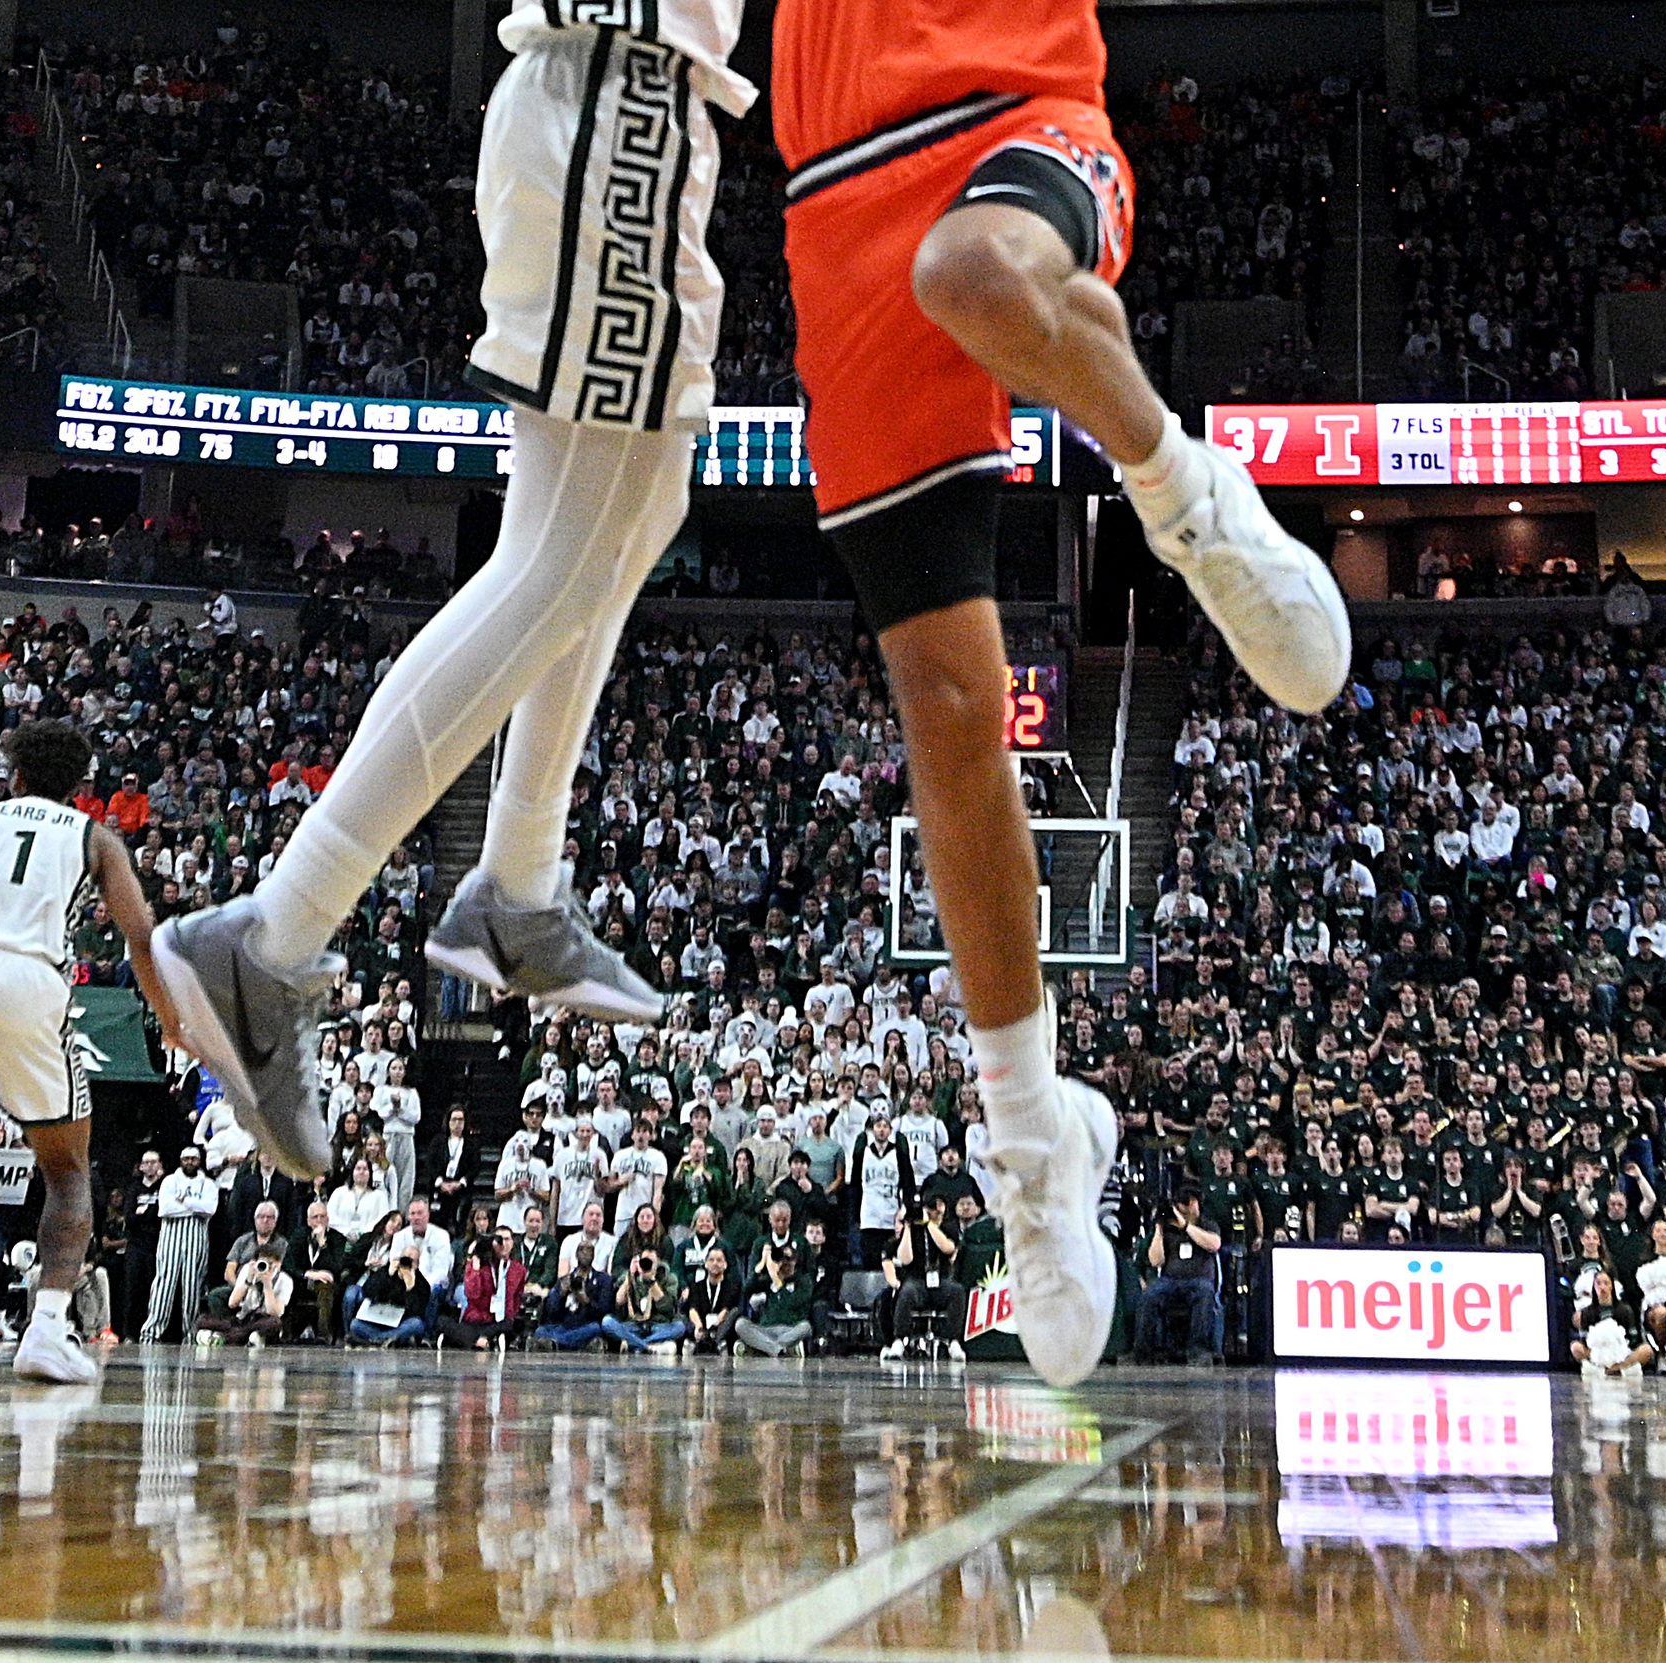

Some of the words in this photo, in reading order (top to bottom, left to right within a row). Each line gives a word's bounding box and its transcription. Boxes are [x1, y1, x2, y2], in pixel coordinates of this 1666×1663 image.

[65, 381, 113, 411] FG%
[194, 394, 241, 422] FT%
[249, 398, 357, 431] FTM-FTA
[1583, 408, 1632, 436] STL
[1223, 417, 1289, 464] 37
[1407, 418, 1443, 434] FLS
[199, 434, 232, 461] 75
[1391, 453, 1403, 470] 3
[1409, 453, 1445, 471] TOL
[10, 830, 37, 885] 1
[1295, 1260, 1524, 1350] meijer
